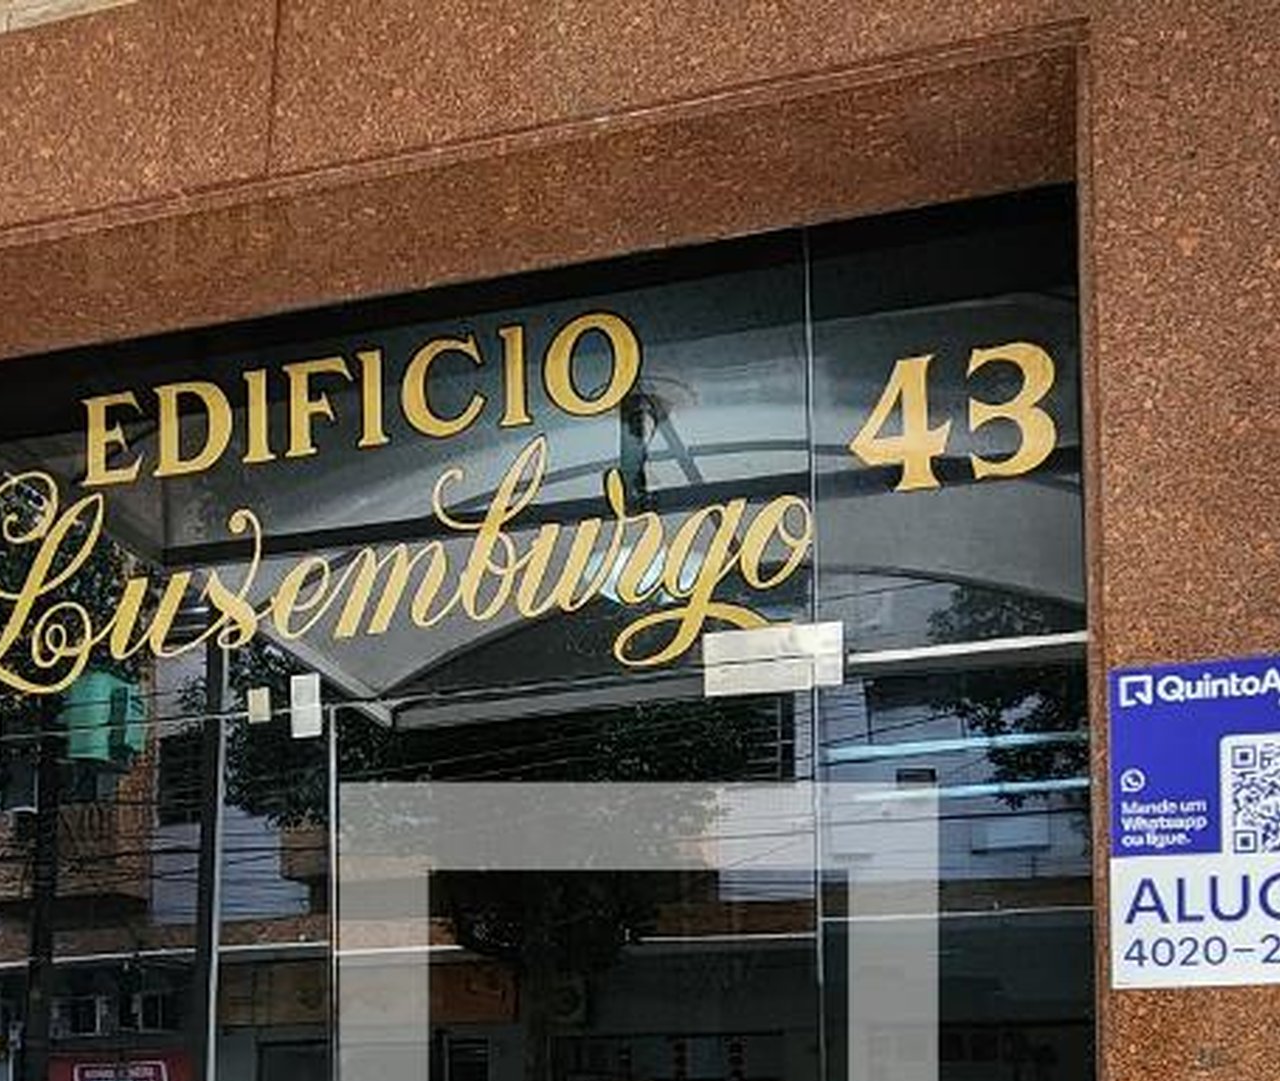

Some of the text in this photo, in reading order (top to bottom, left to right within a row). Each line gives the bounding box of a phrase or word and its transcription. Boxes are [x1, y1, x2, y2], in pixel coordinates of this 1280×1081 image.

[81, 311, 644, 489] EDIFICIO
[849, 342, 1057, 492] 43
[1180, 800, 1208, 813] um
